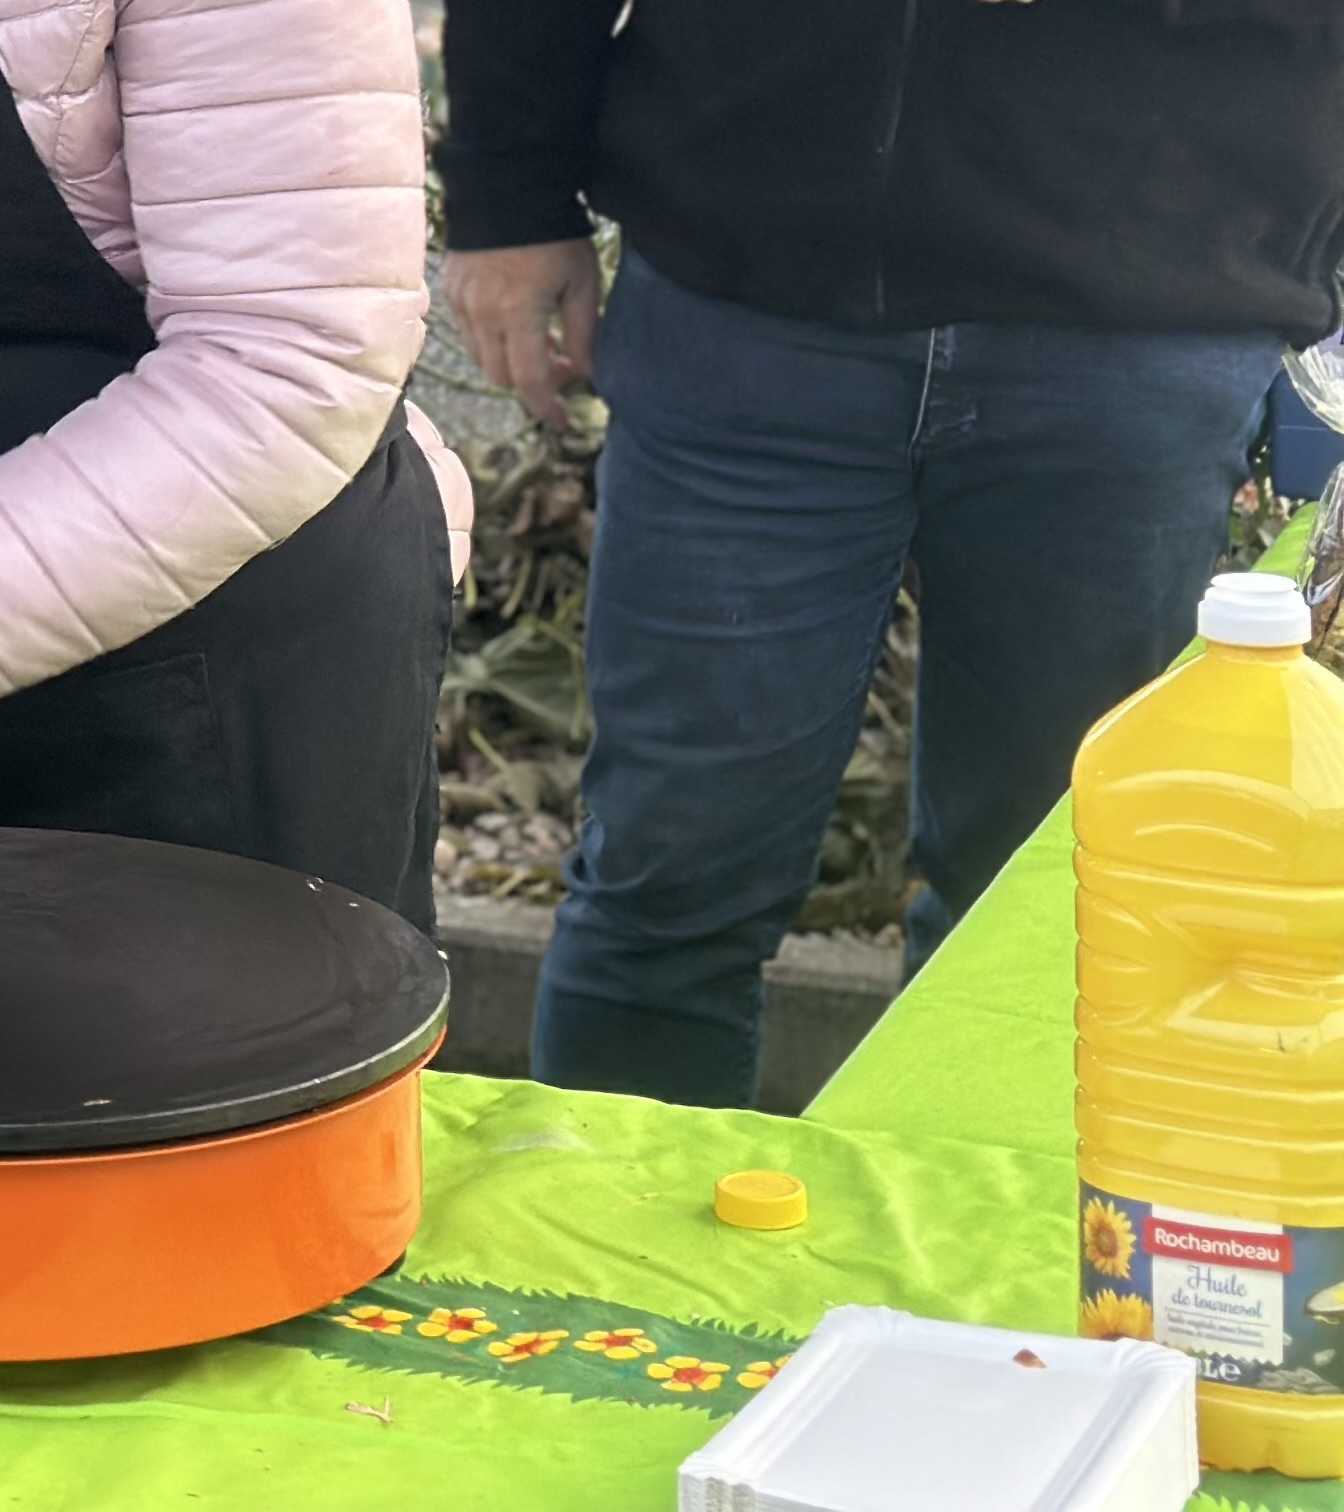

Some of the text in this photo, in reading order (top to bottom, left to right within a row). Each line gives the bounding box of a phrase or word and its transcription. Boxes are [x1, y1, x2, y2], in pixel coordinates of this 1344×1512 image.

[1154, 1227, 1279, 1263] Rochambeau
[1186, 1265, 1248, 1297] Huile
[1171, 1288, 1263, 1318] de tournesol
